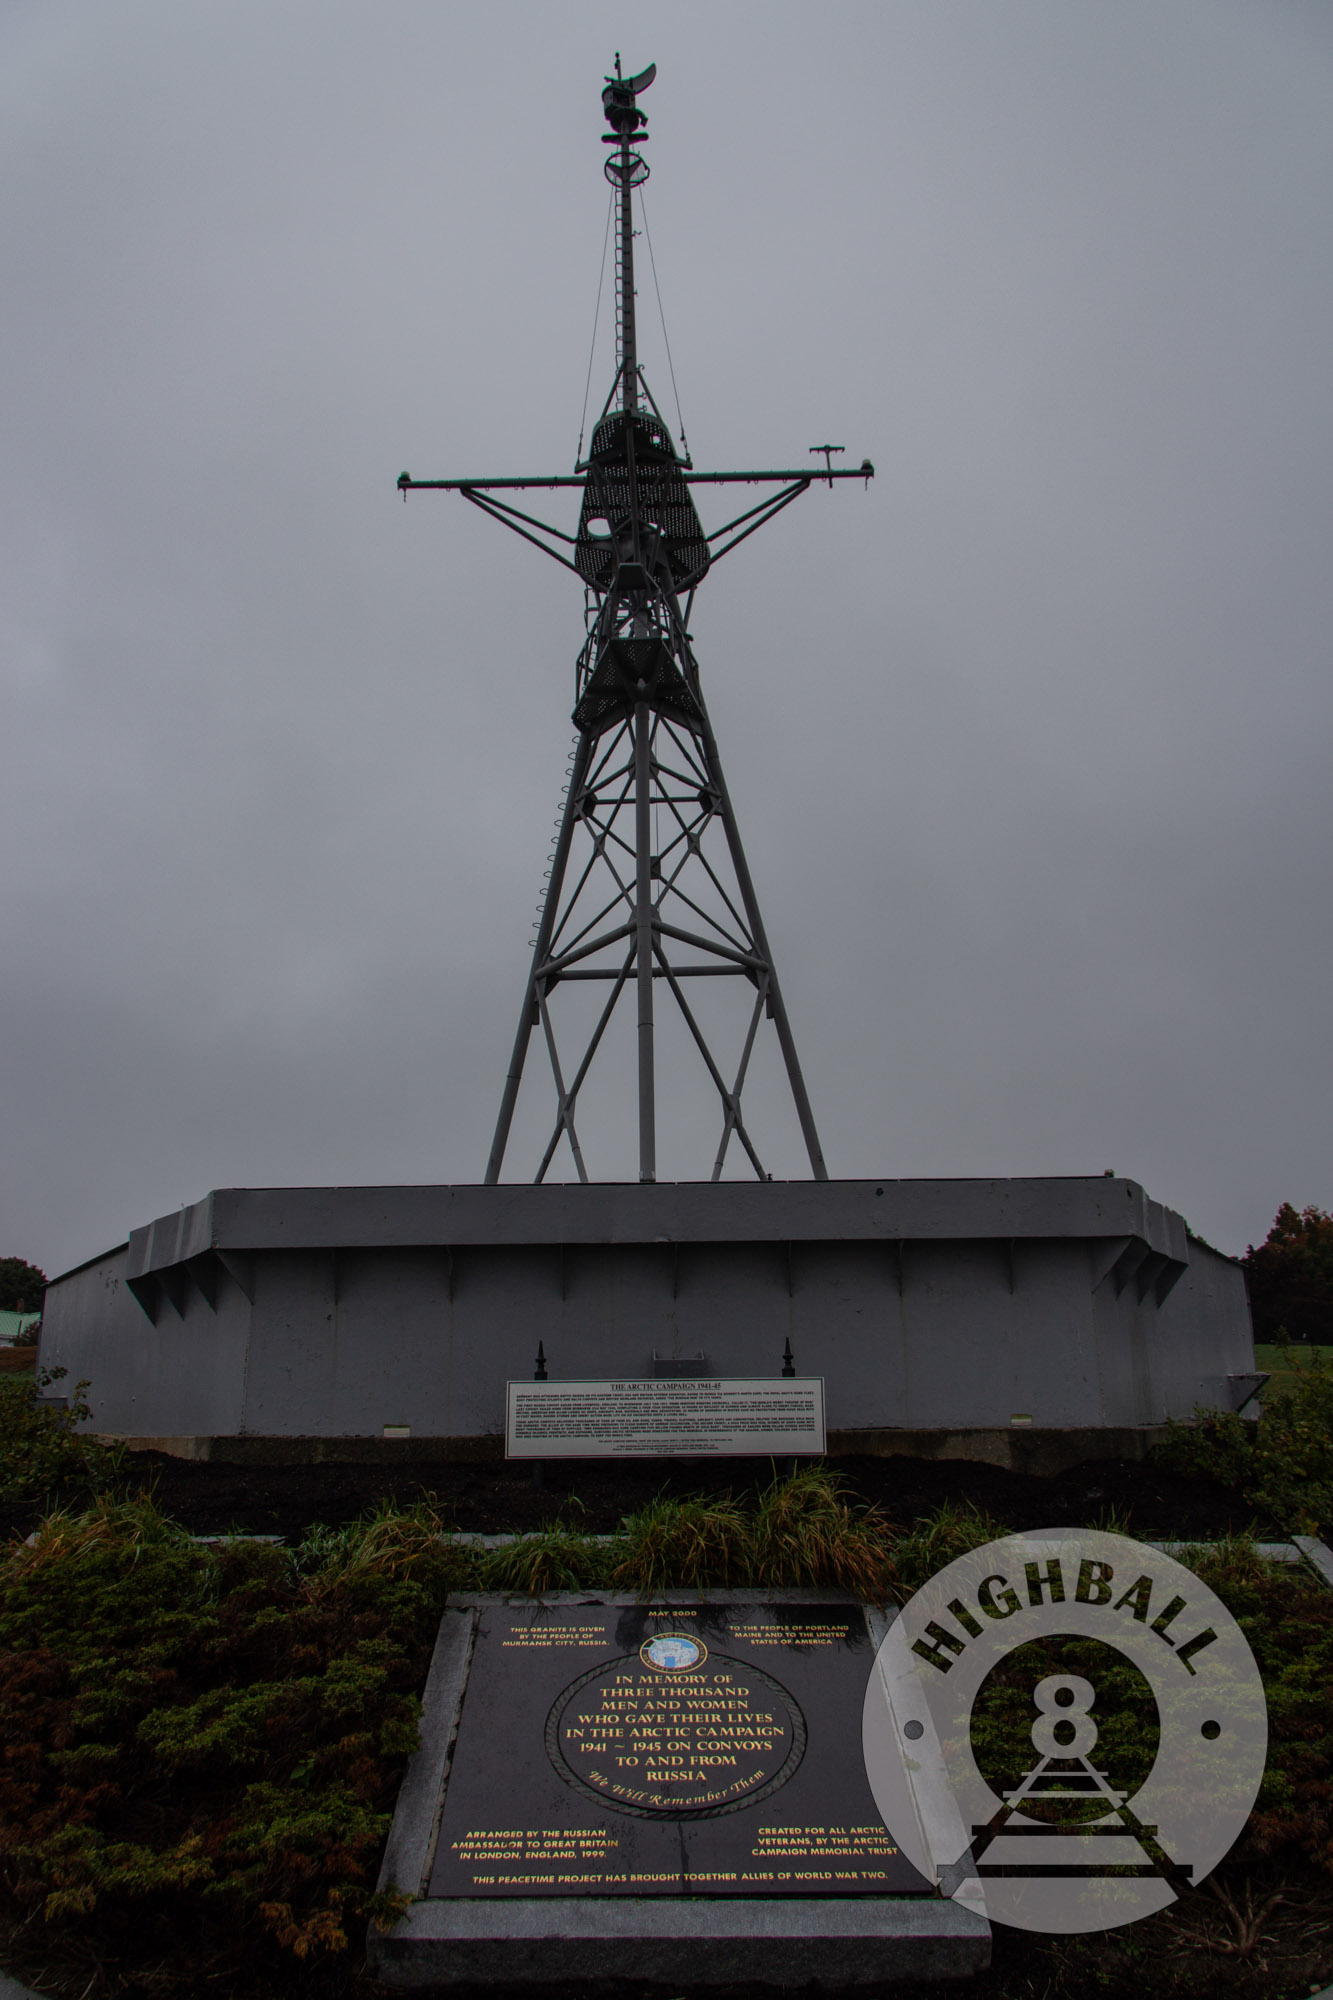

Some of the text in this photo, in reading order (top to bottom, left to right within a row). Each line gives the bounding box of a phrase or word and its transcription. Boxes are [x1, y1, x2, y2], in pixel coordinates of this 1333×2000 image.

[616, 1674, 733, 1684] IN MEMORY OF
[600, 1688, 750, 1697] THREE THOUSAND
[601, 1700, 748, 1710] MEN AND WOMEN
[578, 1714, 773, 1724] WHO GAVE THEIR LIVES
[566, 1726, 784, 1739] IN THE ARCTIC CAMPAIGN
[580, 1743, 606, 1752] 1941
[633, 1742, 661, 1752] 1945
[667, 1741, 691, 1751] ON
[696, 1741, 773, 1751] CONVOYS
[615, 1755, 736, 1767] TO AND FROM
[647, 1771, 707, 1781] RUSSIA
[588, 1769, 764, 1806] We Will Remember Them
[805, 1827, 825, 1835] FOR
[829, 1827, 846, 1835] ALL
[758, 1838, 813, 1846] VETERANS,
[853, 1837, 889, 1845] ARCTIC
[459, 1852, 471, 1860] IN
[474, 1852, 522, 1860] LONDON,
[525, 1851, 577, 1860] ENGLAND,
[752, 1848, 807, 1856] CAMPAIGN
[811, 1848, 864, 1856] MEMORIAL
[473, 1876, 495, 1884] THIS
[499, 1876, 555, 1884] PEACETIME
[558, 1875, 602, 1883] PROJECT
[605, 1875, 627, 1883] HAS
[630, 1874, 680, 1882] BROUGHT
[684, 1873, 737, 1881] TOGETHER
[777, 1872, 791, 1880] OF
[795, 1872, 832, 1880] WORLD
